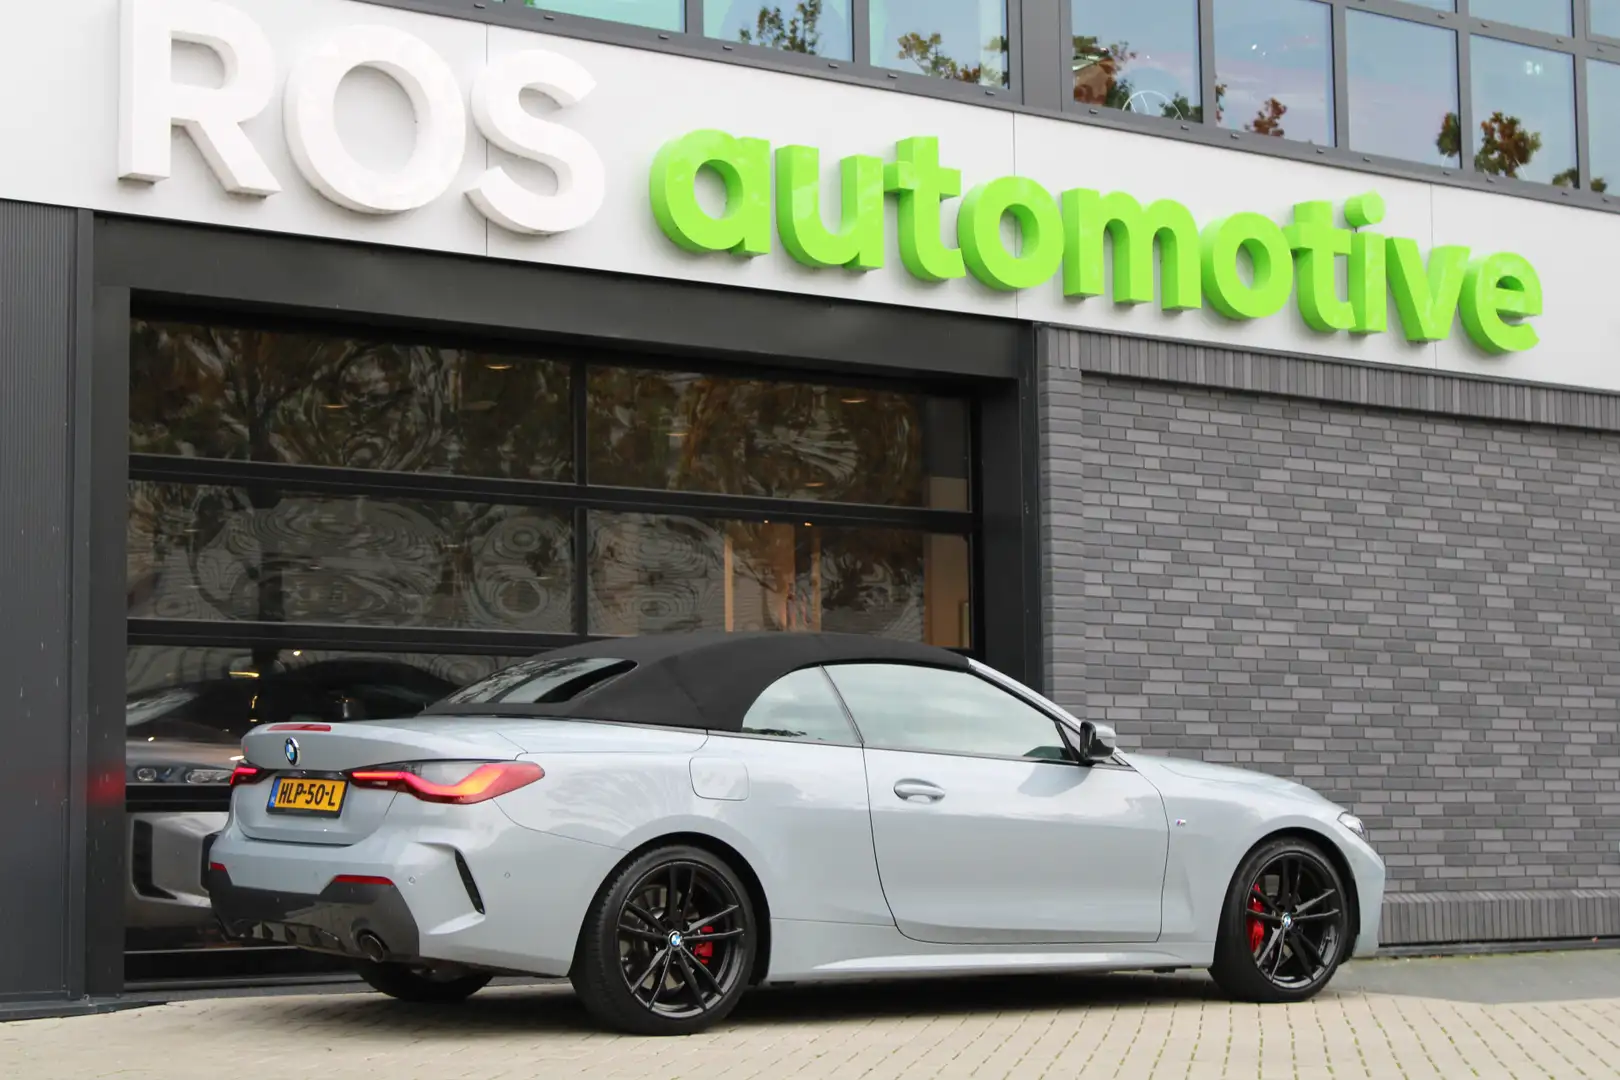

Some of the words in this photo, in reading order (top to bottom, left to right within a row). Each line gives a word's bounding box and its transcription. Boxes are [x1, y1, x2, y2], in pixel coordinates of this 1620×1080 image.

[118, 0, 605, 236] ROS
[650, 130, 1543, 353] automotive
[278, 782, 336, 807] HLP-50-L
